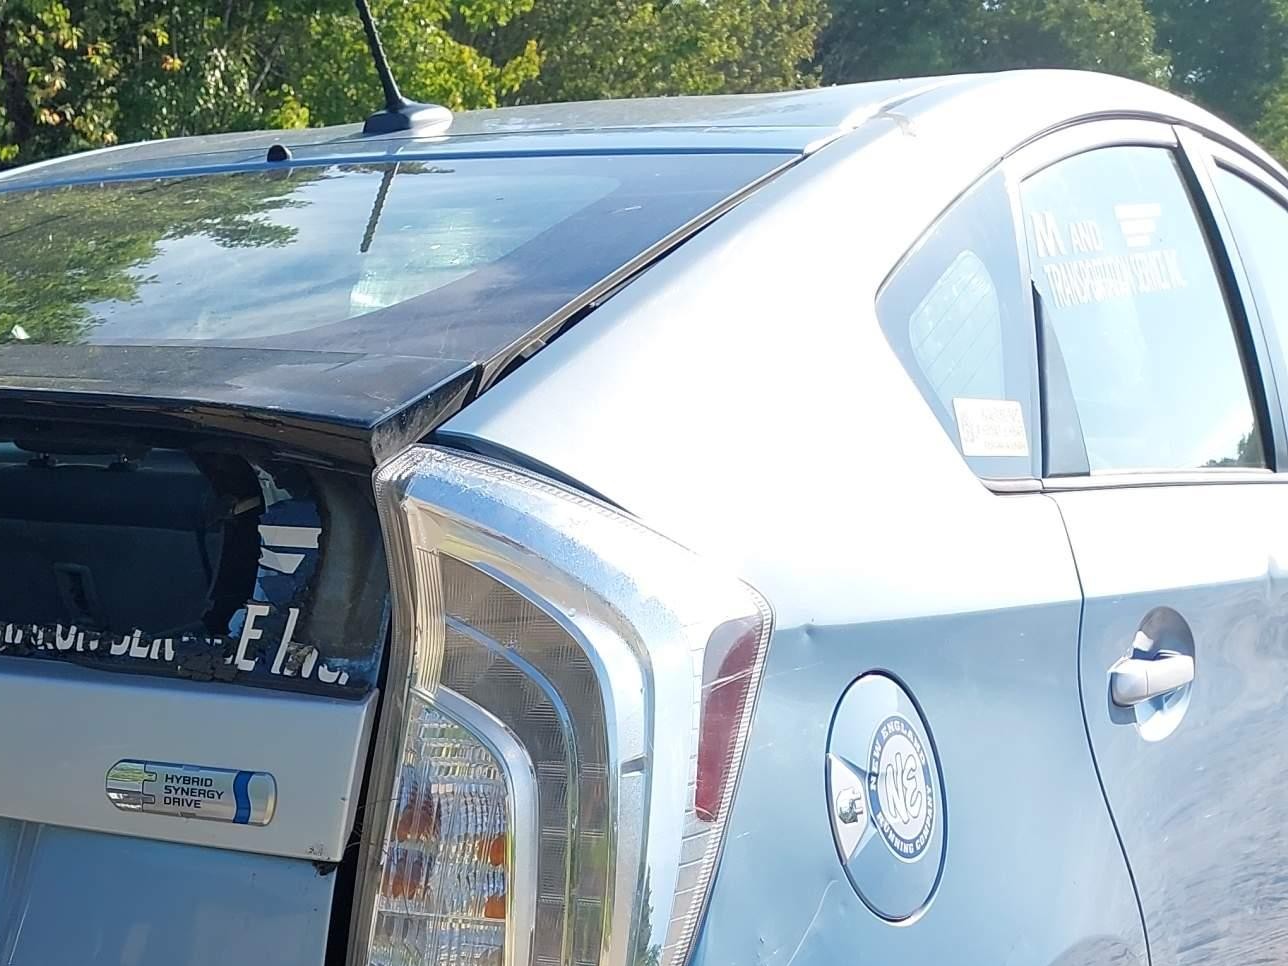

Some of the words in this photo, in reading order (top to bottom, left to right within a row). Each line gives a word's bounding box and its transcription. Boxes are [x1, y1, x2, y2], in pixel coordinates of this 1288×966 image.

[870, 739, 881, 790] NEW
[880, 719, 926, 766] ENGLAND
[165, 773, 213, 788] HYBRID
[163, 785, 225, 800] SYNERGY
[163, 796, 201, 809] DRIVE
[876, 811, 914, 854] RUNNING
